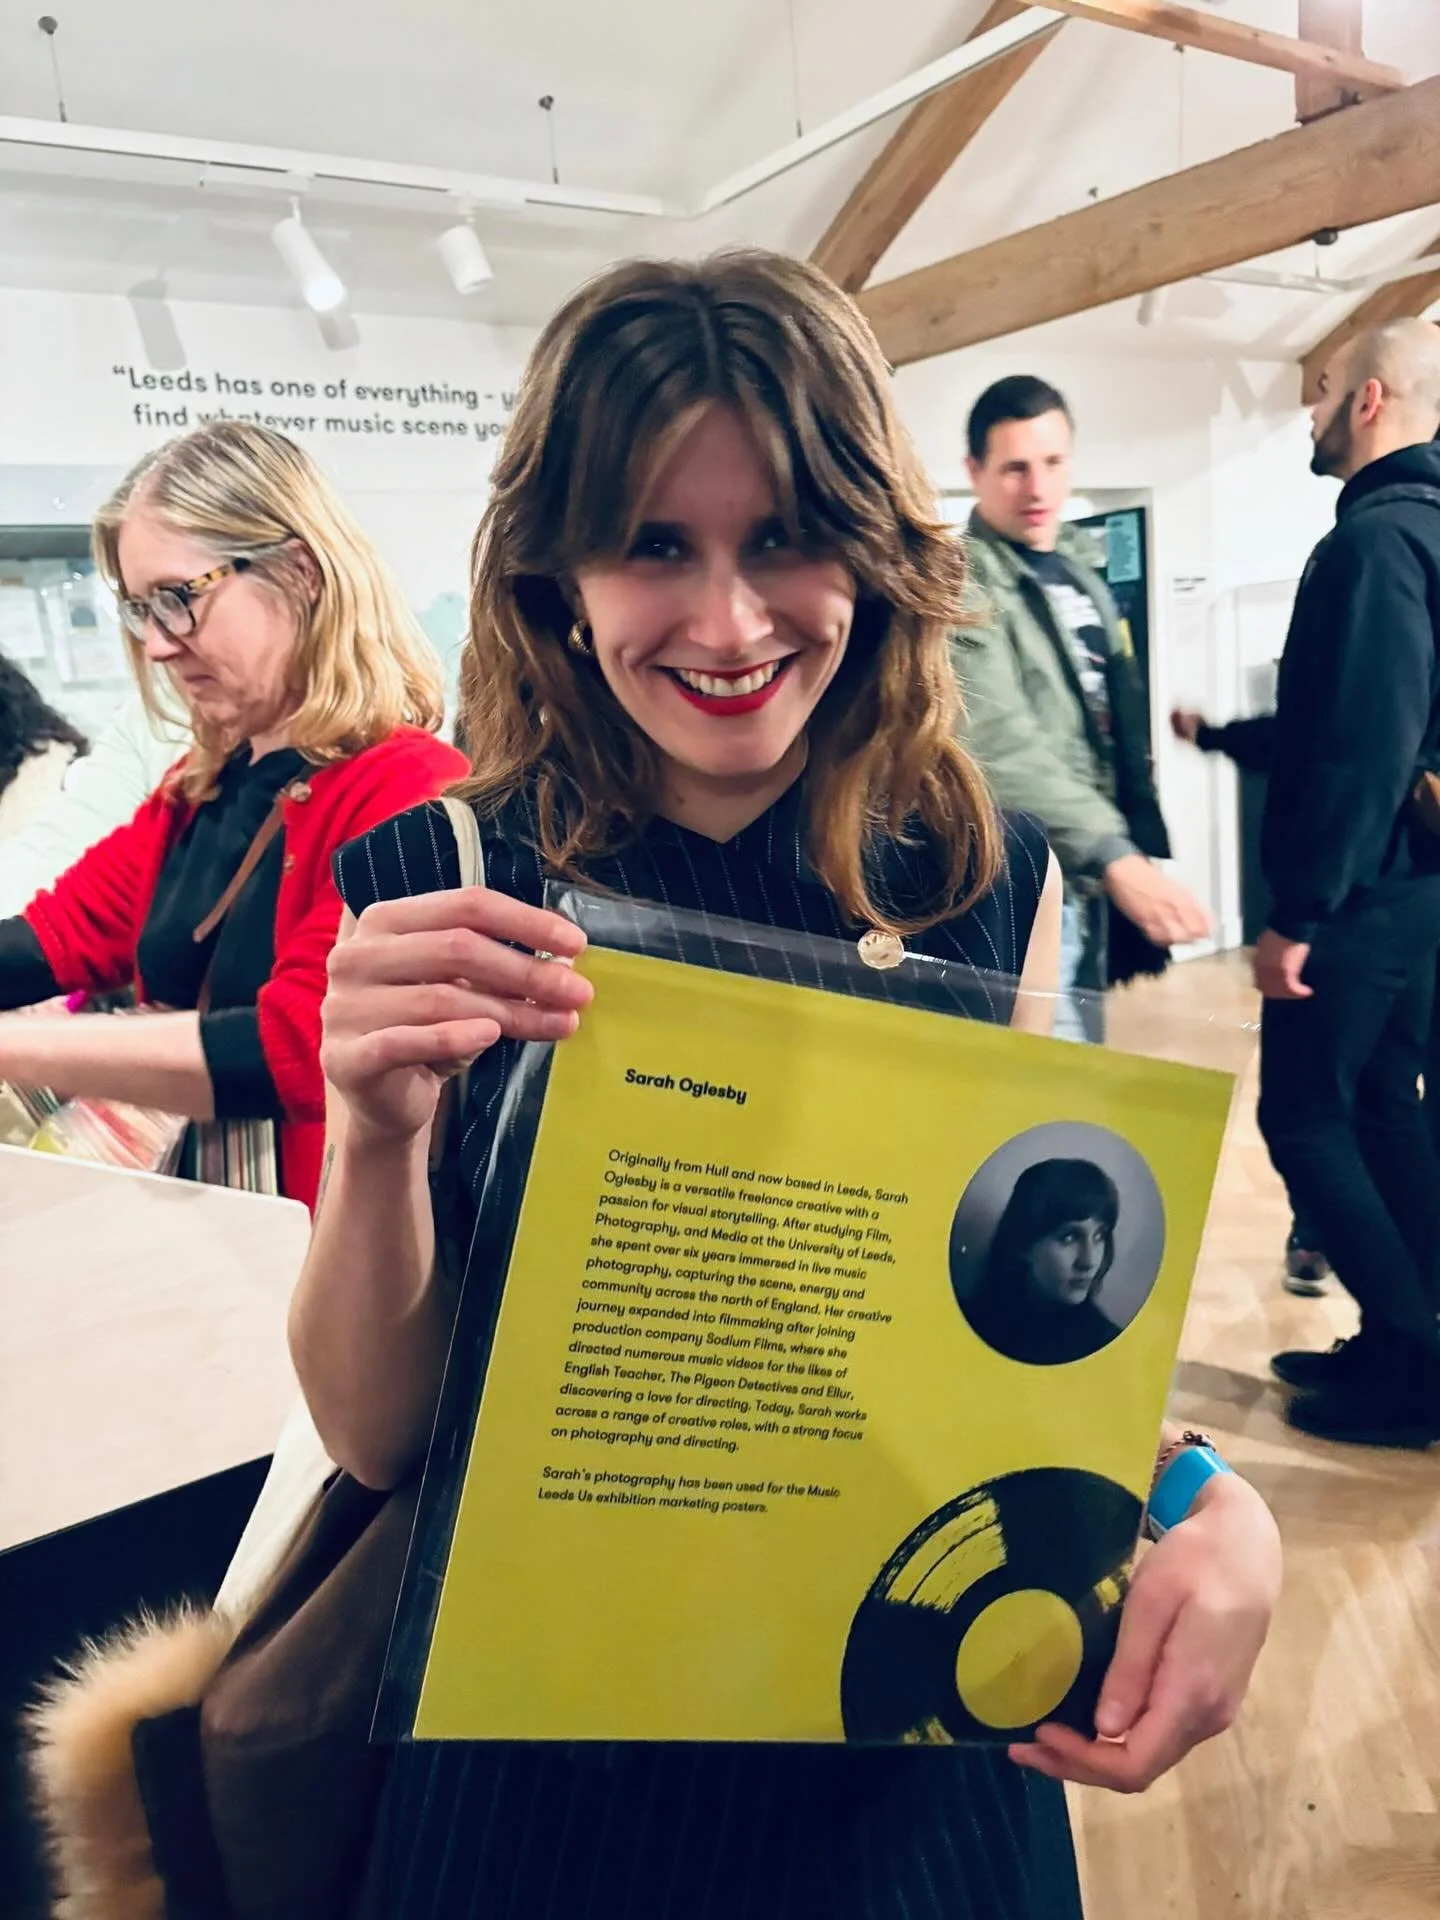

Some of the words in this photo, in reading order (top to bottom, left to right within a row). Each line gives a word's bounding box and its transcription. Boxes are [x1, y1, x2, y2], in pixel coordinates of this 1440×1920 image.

[215, 372, 263, 395] has
[270, 381, 316, 398] one
[325, 380, 347, 399] of
[355, 383, 479, 409] everything
[133, 404, 188, 427] find
[325, 413, 395, 434] music
[402, 418, 467, 436] scene
[474, 422, 507, 441] yo
[624, 1068, 675, 1090] Sarah
[678, 1077, 747, 1105] Oglesby
[604, 1170, 657, 1192] Oglesby
[660, 1178, 670, 1190] is
[673, 1183, 681, 1192] a
[685, 1185, 735, 1199] versatile
[738, 1189, 793, 1208] freelance
[796, 1200, 842, 1215] creative
[845, 1205, 868, 1218] with
[871, 1211, 879, 1220] a
[608, 1149, 670, 1172] Originally
[674, 1158, 702, 1174] from
[705, 1163, 729, 1177] Hull
[731, 1169, 755, 1181] and
[758, 1174, 783, 1184] now
[785, 1174, 821, 1191] based
[823, 1181, 834, 1192] in
[836, 1182, 871, 1200] Leeds,
[875, 1188, 908, 1204] Sarah
[598, 1195, 648, 1209] passion
[652, 1198, 669, 1211] for
[672, 1202, 707, 1217] visual
[710, 1208, 779, 1229] storytelling.
[782, 1217, 811, 1230] After
[813, 1223, 863, 1241] studying
[865, 1228, 891, 1244] Film,
[590, 1234, 613, 1248] she
[616, 1240, 651, 1253] spent
[653, 1245, 681, 1255] over
[683, 1246, 699, 1258] six
[701, 1251, 736, 1263] years
[738, 1252, 796, 1270] immersed
[798, 1260, 809, 1272] in
[811, 1261, 831, 1275] live
[833, 1267, 867, 1279] music
[683, 1226, 708, 1238] and
[711, 1227, 748, 1244] Media
[750, 1235, 763, 1245] at
[766, 1236, 785, 1248] the
[788, 1237, 844, 1259] University
[847, 1246, 860, 1258] of
[861, 1248, 895, 1264] Leeds,
[581, 1280, 652, 1298] community
[655, 1288, 695, 1300] across
[699, 1290, 718, 1302] the
[721, 1295, 752, 1307] north
[755, 1296, 769, 1308] of
[824, 1304, 844, 1317] Her
[847, 1310, 892, 1324] creative
[675, 1269, 734, 1287] capturing
[738, 1273, 756, 1286] the
[759, 1279, 796, 1292] scene,
[799, 1284, 840, 1300] energy
[842, 1288, 865, 1299] and
[576, 1297, 625, 1317] journey
[628, 1306, 690, 1320] expanded
[692, 1309, 716, 1323] into
[719, 1313, 783, 1334] filmmaking
[786, 1321, 815, 1334] after
[816, 1324, 855, 1342] joining
[572, 1321, 642, 1336] production
[645, 1329, 703, 1347] company
[706, 1332, 750, 1348] Sodium
[753, 1337, 786, 1353] Films,
[790, 1342, 824, 1356] where
[827, 1346, 847, 1358] she
[568, 1340, 622, 1356] directed
[624, 1349, 685, 1362] numerous
[687, 1354, 723, 1366] music
[726, 1356, 764, 1370] videos
[767, 1359, 784, 1372] for
[786, 1362, 805, 1374] the
[807, 1363, 832, 1377] likes
[835, 1367, 848, 1378] of
[564, 1361, 609, 1378] English
[614, 1365, 665, 1383] Teacher,
[670, 1370, 690, 1384] The
[693, 1373, 735, 1389] Pigeon
[737, 1376, 798, 1394] Detectives
[801, 1385, 824, 1396] and
[559, 1383, 632, 1403] discovering
[635, 1392, 644, 1401] a
[647, 1390, 672, 1403] love
[675, 1392, 693, 1404] for
[695, 1395, 751, 1413] directing.
[756, 1399, 794, 1417] Today,
[798, 1403, 831, 1417] Sarah
[834, 1408, 867, 1420] works
[551, 1427, 568, 1437] on
[570, 1427, 653, 1447] photography
[655, 1434, 681, 1446] and
[683, 1435, 739, 1453] directing.
[555, 1406, 597, 1418] across
[600, 1410, 609, 1419] a
[612, 1411, 649, 1425] range
[652, 1412, 667, 1423] of
[668, 1416, 717, 1428] creative
[719, 1418, 750, 1432] roles,
[754, 1421, 779, 1433] with
[781, 1425, 790, 1434] a
[792, 1425, 829, 1440] strong
[832, 1427, 863, 1440] focus
[538, 1487, 574, 1500] Leeds
[578, 1489, 593, 1502] Us
[595, 1492, 656, 1505] exhibition
[658, 1497, 719, 1512] marketing
[721, 1502, 768, 1512] posters.
[593, 1470, 675, 1490] photography
[678, 1475, 700, 1488] has
[703, 1477, 733, 1490] been
[735, 1481, 764, 1492] used
[767, 1481, 784, 1494] for
[786, 1483, 805, 1495] the
[807, 1484, 840, 1497] Music
